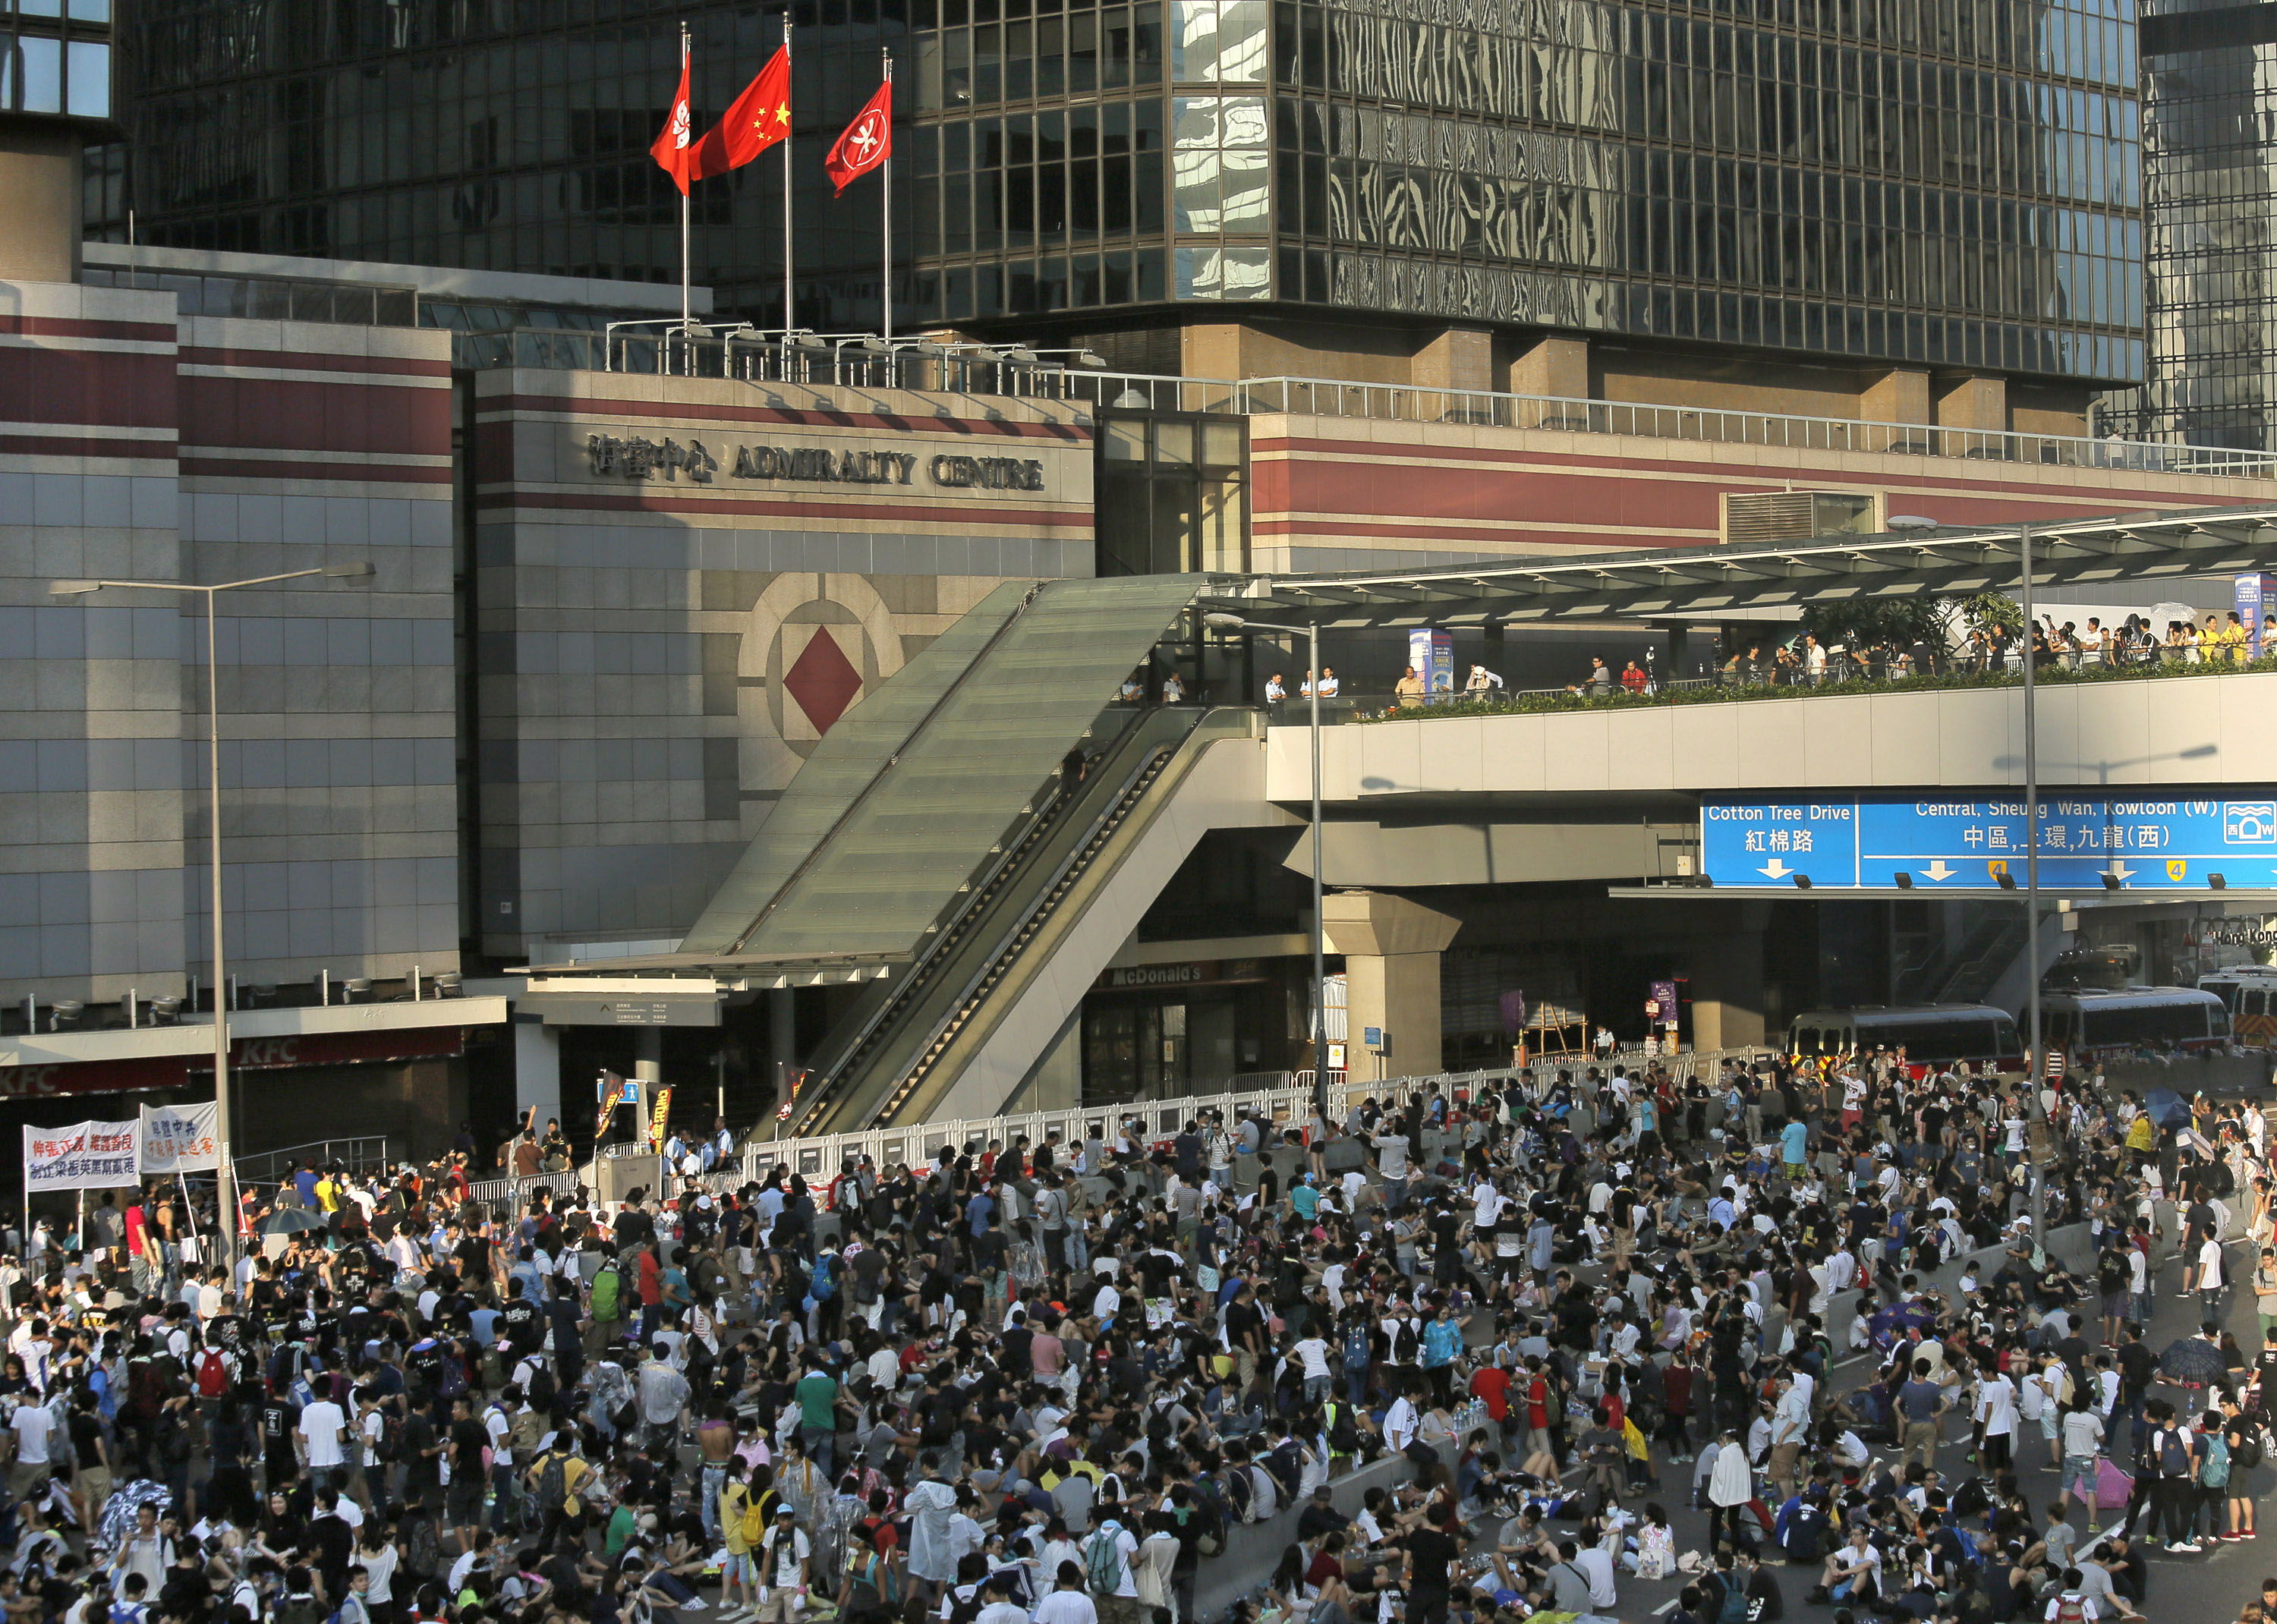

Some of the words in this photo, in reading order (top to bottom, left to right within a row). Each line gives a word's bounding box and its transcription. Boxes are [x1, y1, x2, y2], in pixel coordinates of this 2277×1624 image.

[730, 445, 917, 484] ADMIRALTY
[928, 455, 1044, 490] CENTRE
[1709, 806, 1763, 820] Cotton
[1768, 805, 1802, 820] Tree
[1810, 804, 1850, 820] Drive
[1916, 801, 1981, 817] Central,
[2058, 801, 2096, 817] Wan,
[2104, 800, 2176, 815] Kowloon
[2184, 799, 2218, 817] (W)
[2227, 824, 2239, 836] 西
[2261, 824, 2274, 836] W
[1745, 829, 1814, 852] 紅棉路
[1992, 864, 2002, 875] 4
[2171, 864, 2182, 877] 4
[1113, 965, 1201, 986] McDonald's
[239, 1037, 299, 1064] KFC
